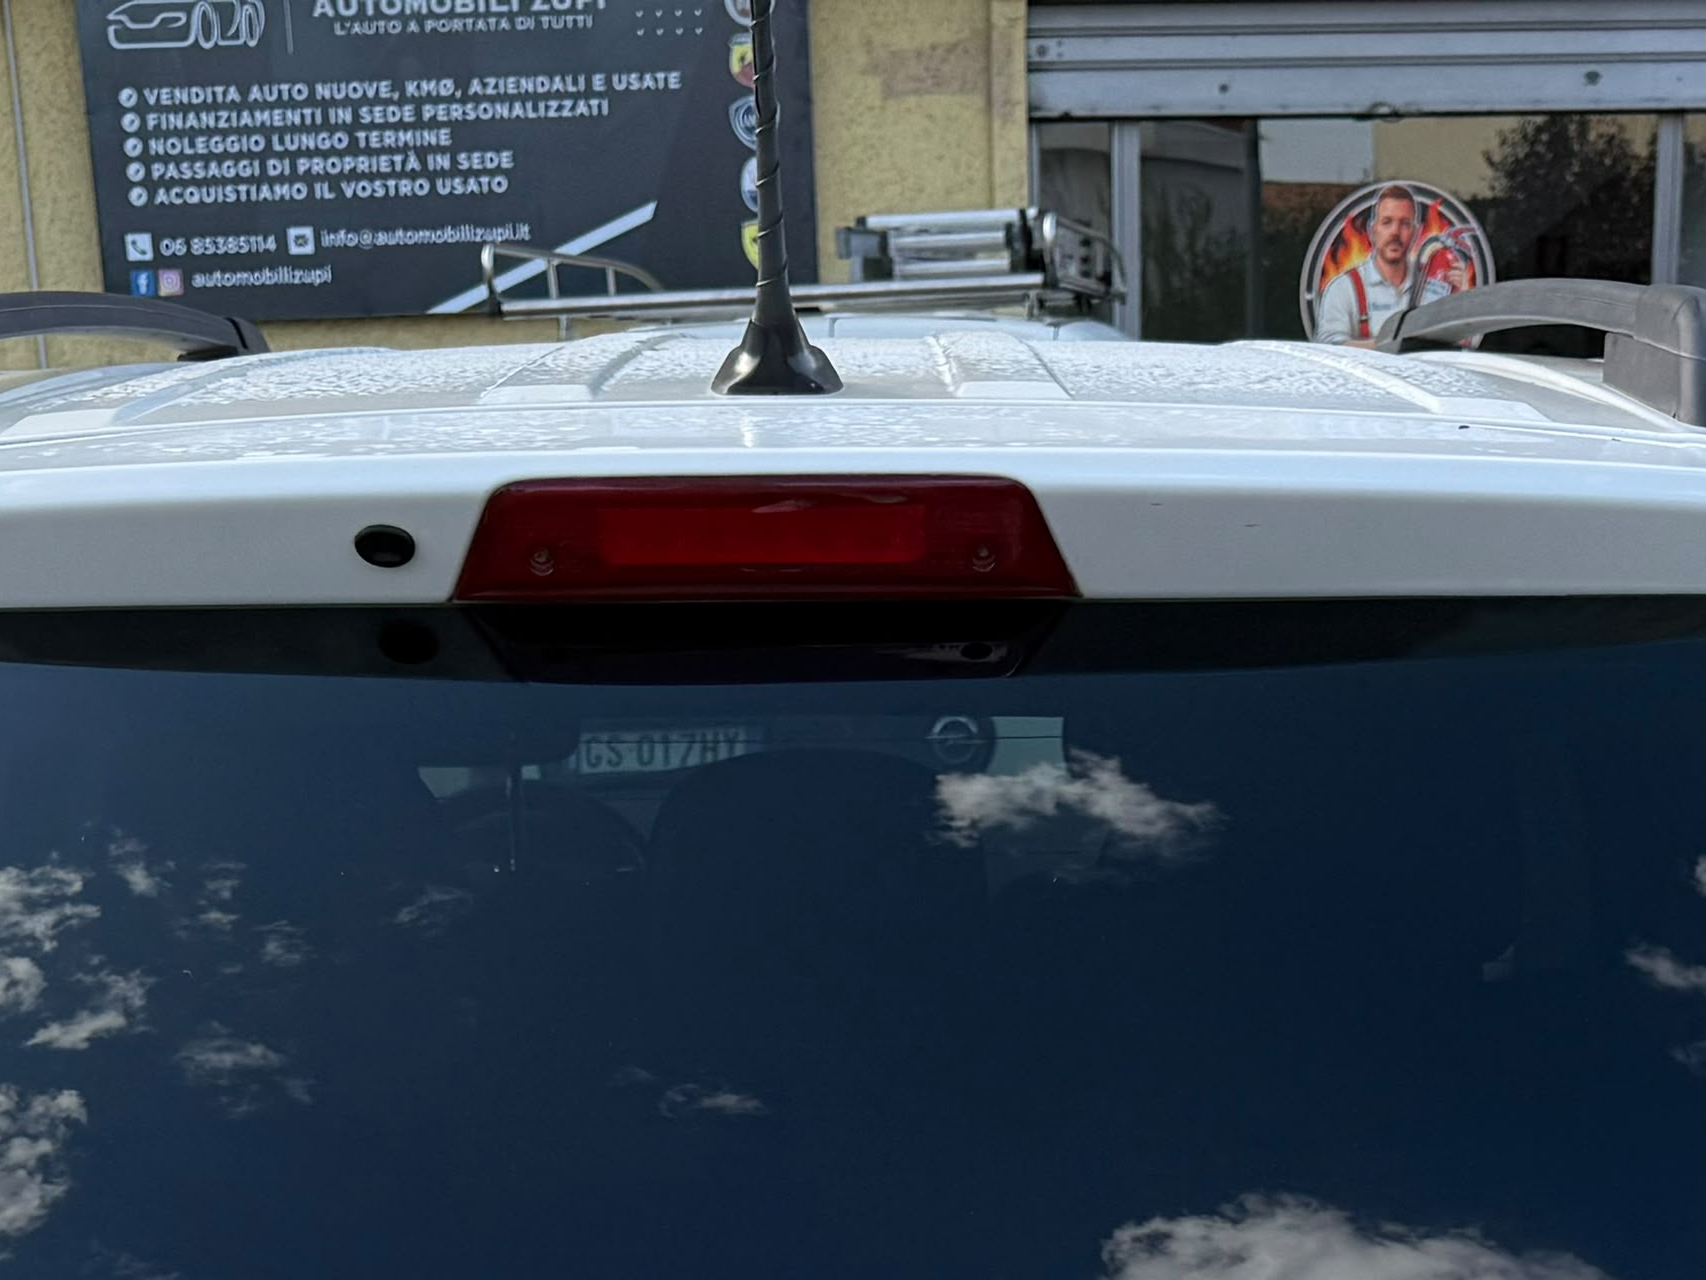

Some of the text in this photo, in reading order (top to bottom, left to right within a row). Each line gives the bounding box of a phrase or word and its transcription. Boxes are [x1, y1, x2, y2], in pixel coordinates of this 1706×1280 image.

[333, 13, 593, 36] L'AUTO A PORTATA DI TUTTI
[143, 84, 241, 106] VENDITA
[247, 82, 309, 103] AUTO
[314, 80, 399, 101] NUOVE,
[467, 74, 586, 96] AZIENDALI
[591, 73, 606, 92] E
[611, 71, 682, 91] USATE
[146, 98, 609, 131] FINANZIAMENTI IN SEDE PERSONALIZZATI
[148, 128, 452, 156] NOLEGGIO LUNGO TERMINE
[150, 150, 515, 180] PASSAGGI DI PROPRIETÀ IN SEDE
[153, 175, 508, 206] ACQUISTIAMO IL VOSTRO USATO
[159, 236, 187, 256] 06
[320, 222, 531, 250] info@automobilizupi.it
[192, 264, 332, 288] automobilizupi
